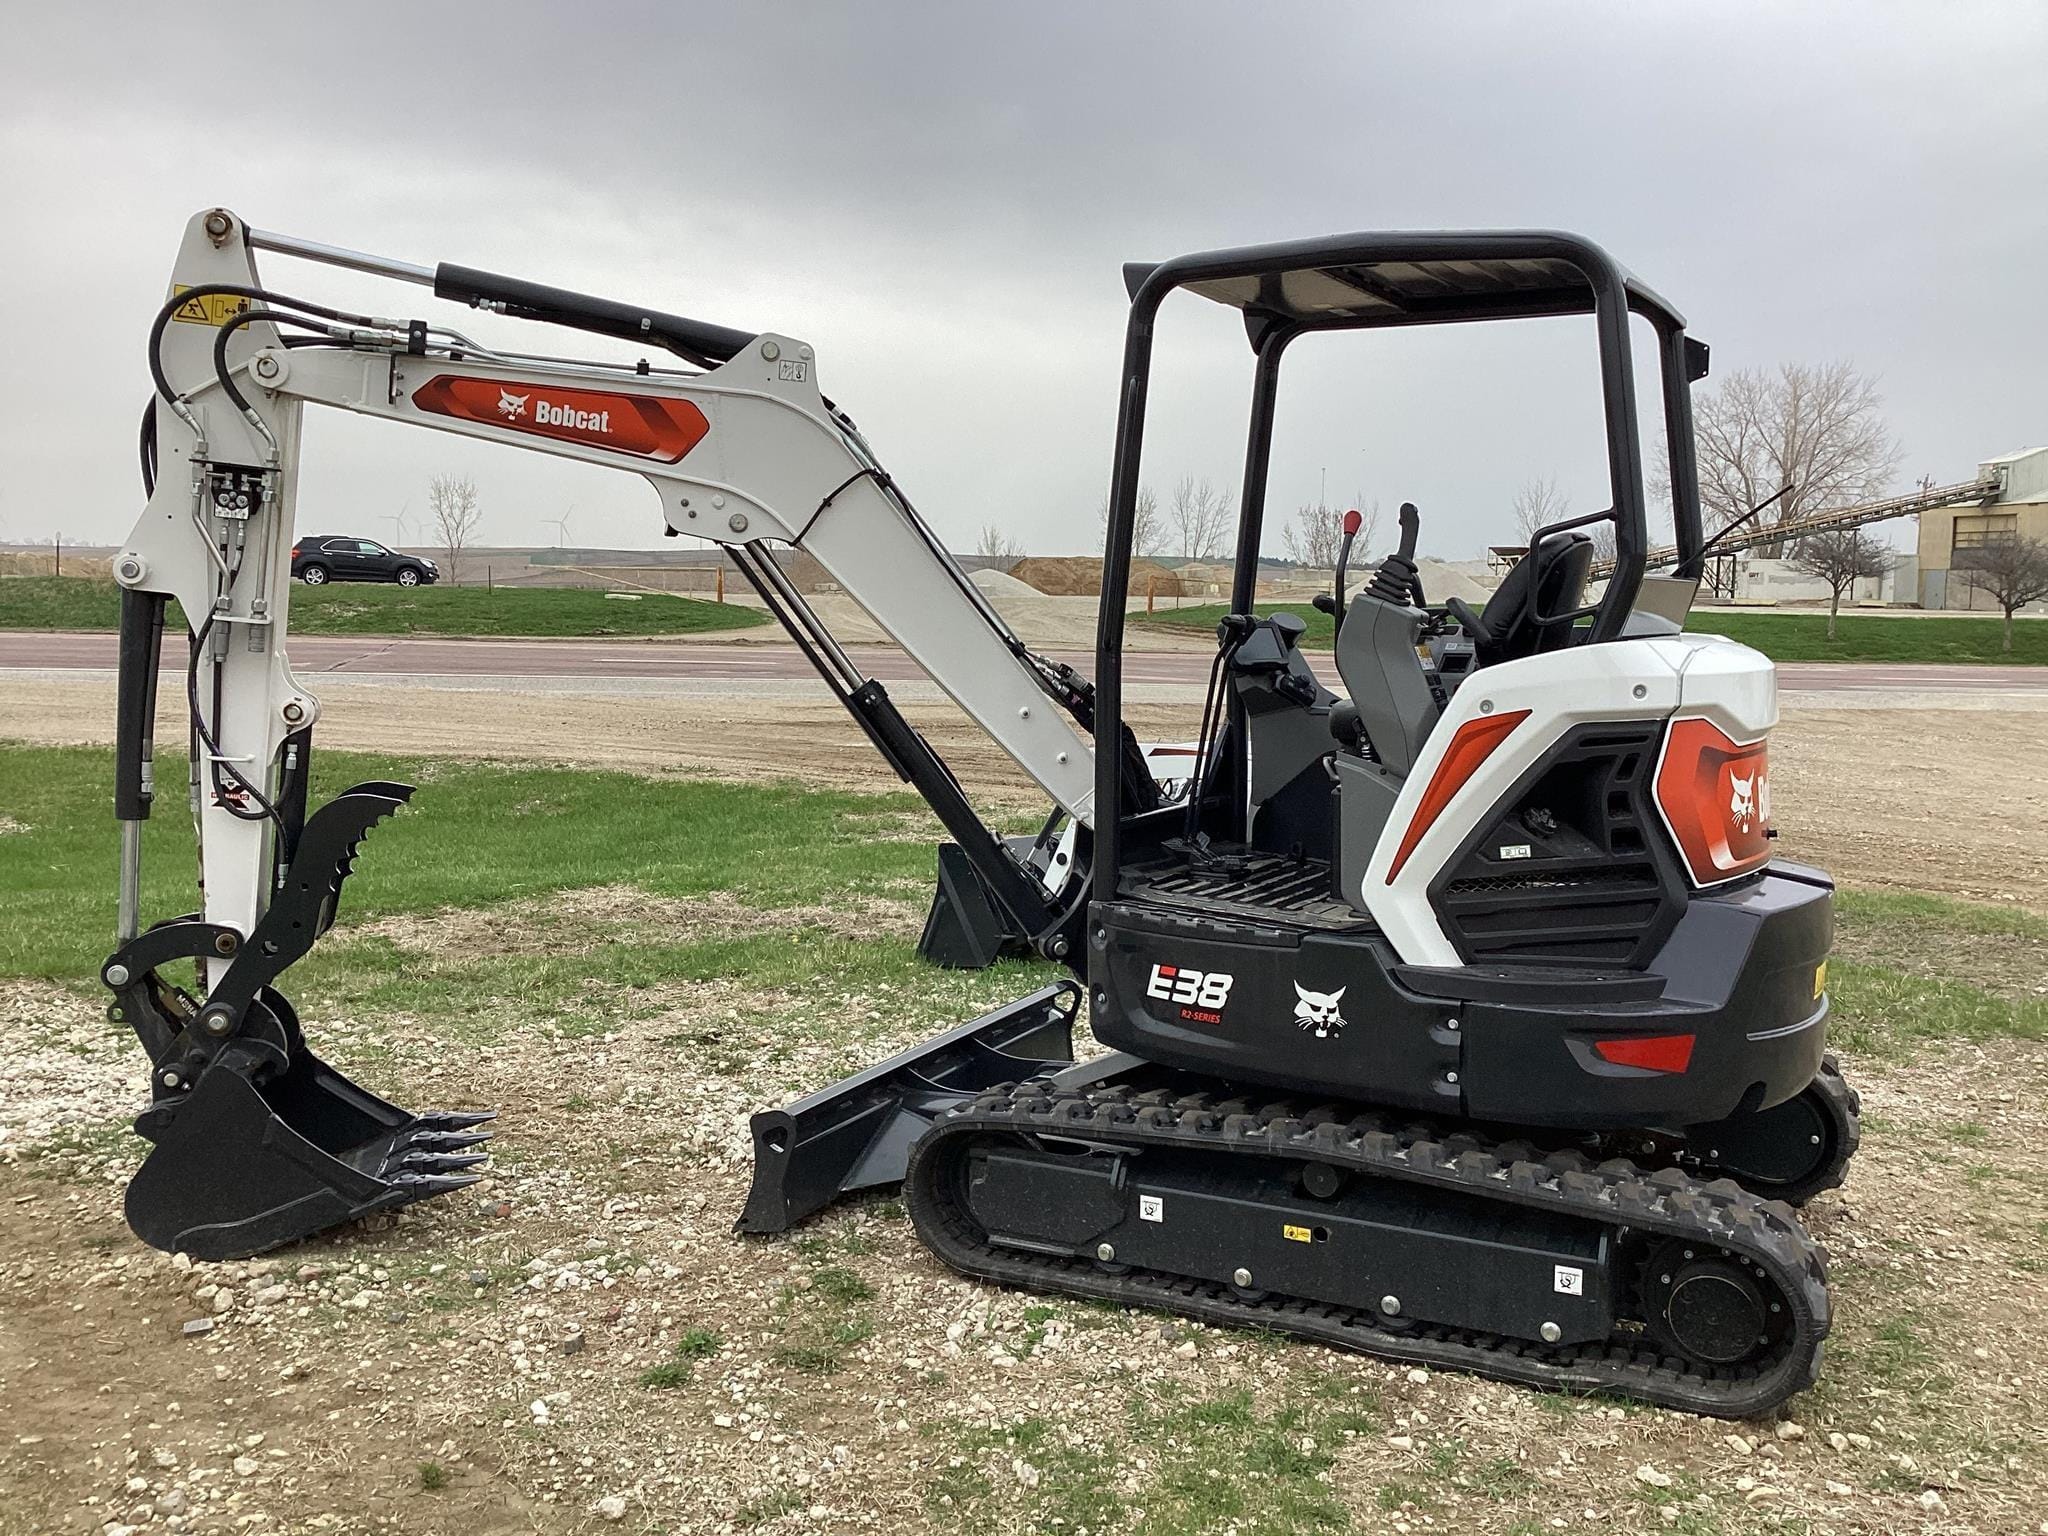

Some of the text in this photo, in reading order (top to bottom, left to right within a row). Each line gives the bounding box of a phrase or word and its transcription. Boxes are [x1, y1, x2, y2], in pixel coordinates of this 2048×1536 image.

[535, 400, 610, 433] Bobcat
[1146, 963, 1234, 1009] E38
[1180, 1009, 1221, 1024] R2-SERIES
